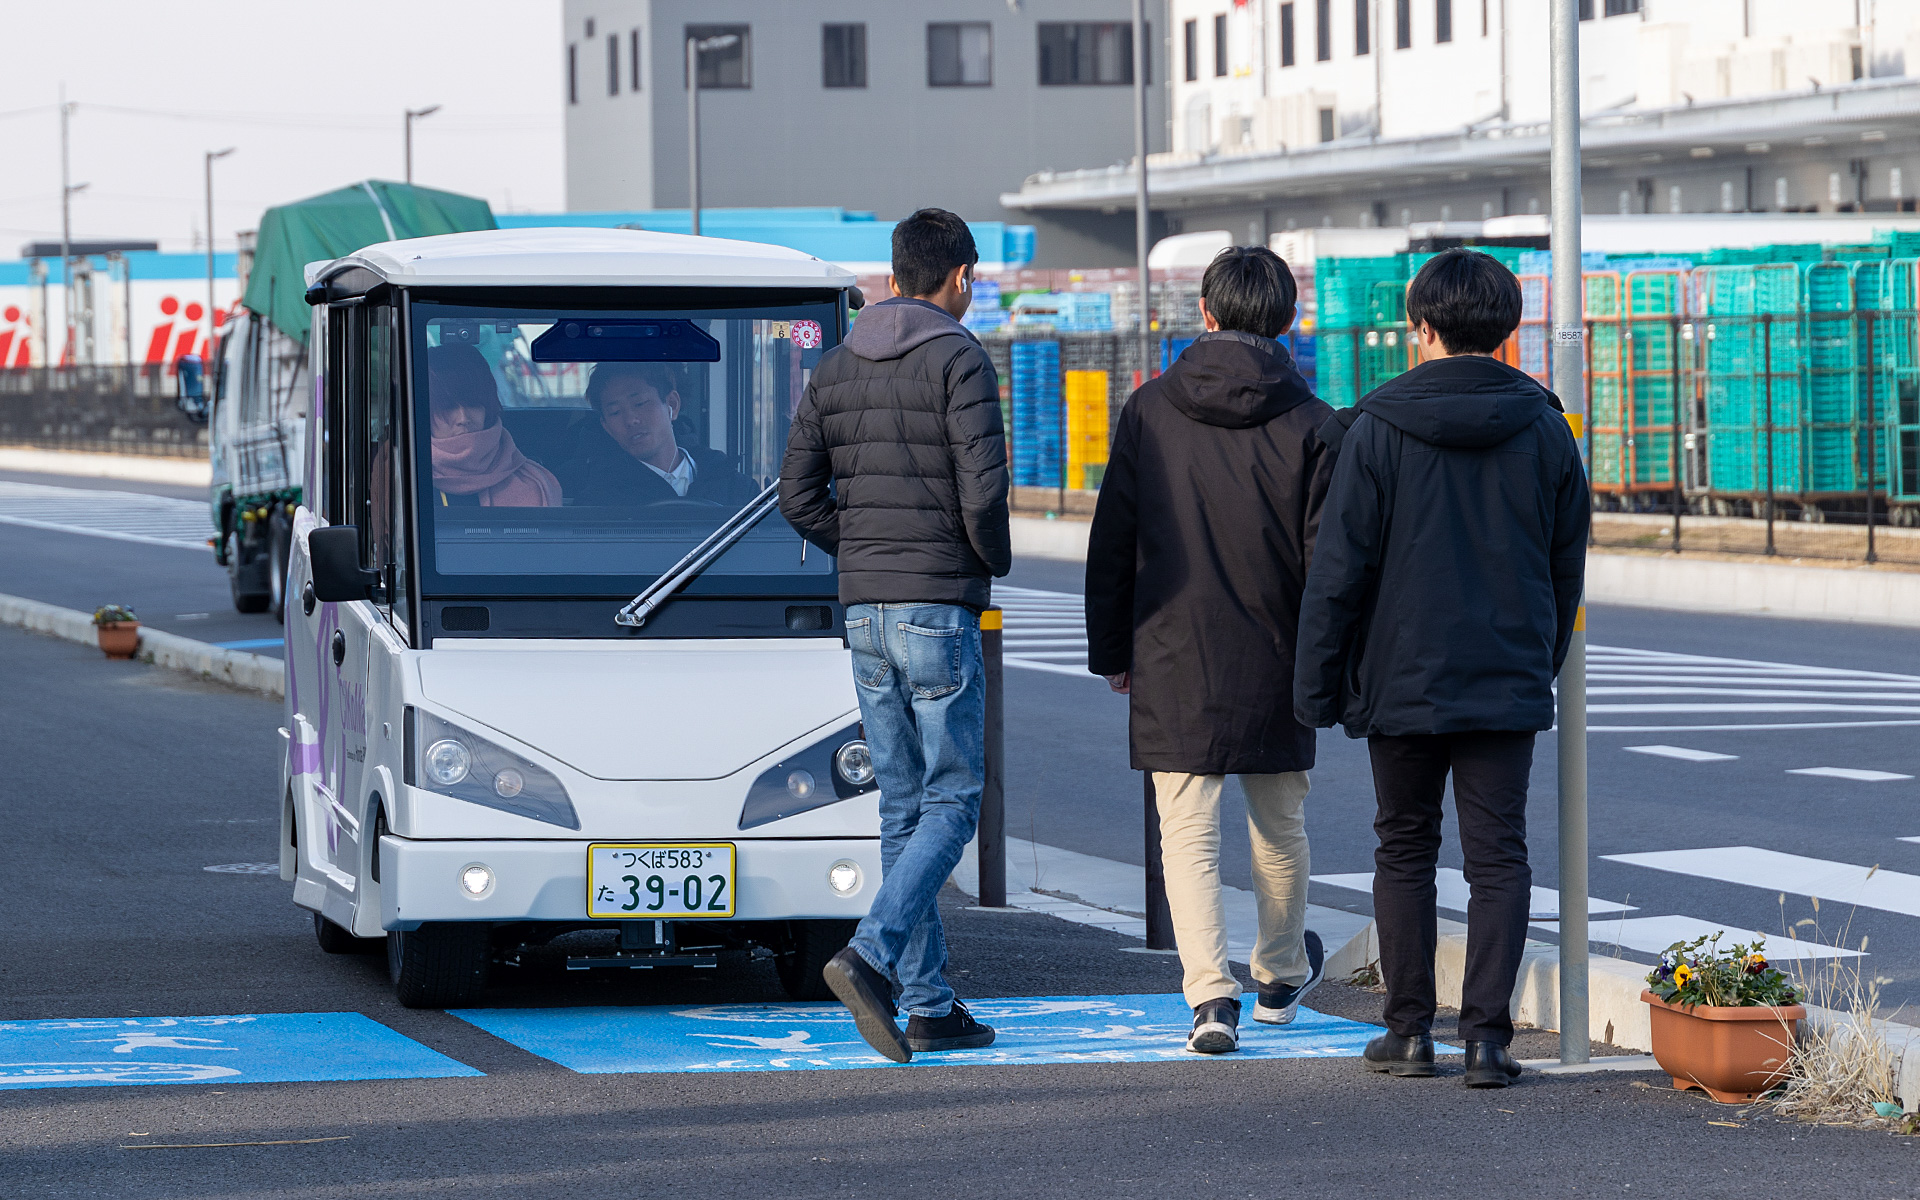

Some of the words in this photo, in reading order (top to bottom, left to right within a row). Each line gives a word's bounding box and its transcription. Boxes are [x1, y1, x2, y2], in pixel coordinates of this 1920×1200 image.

[778, 330, 785, 338] 6
[803, 331, 810, 339] 6
[597, 885, 615, 902] た
[621, 874, 726, 911] 39-02
